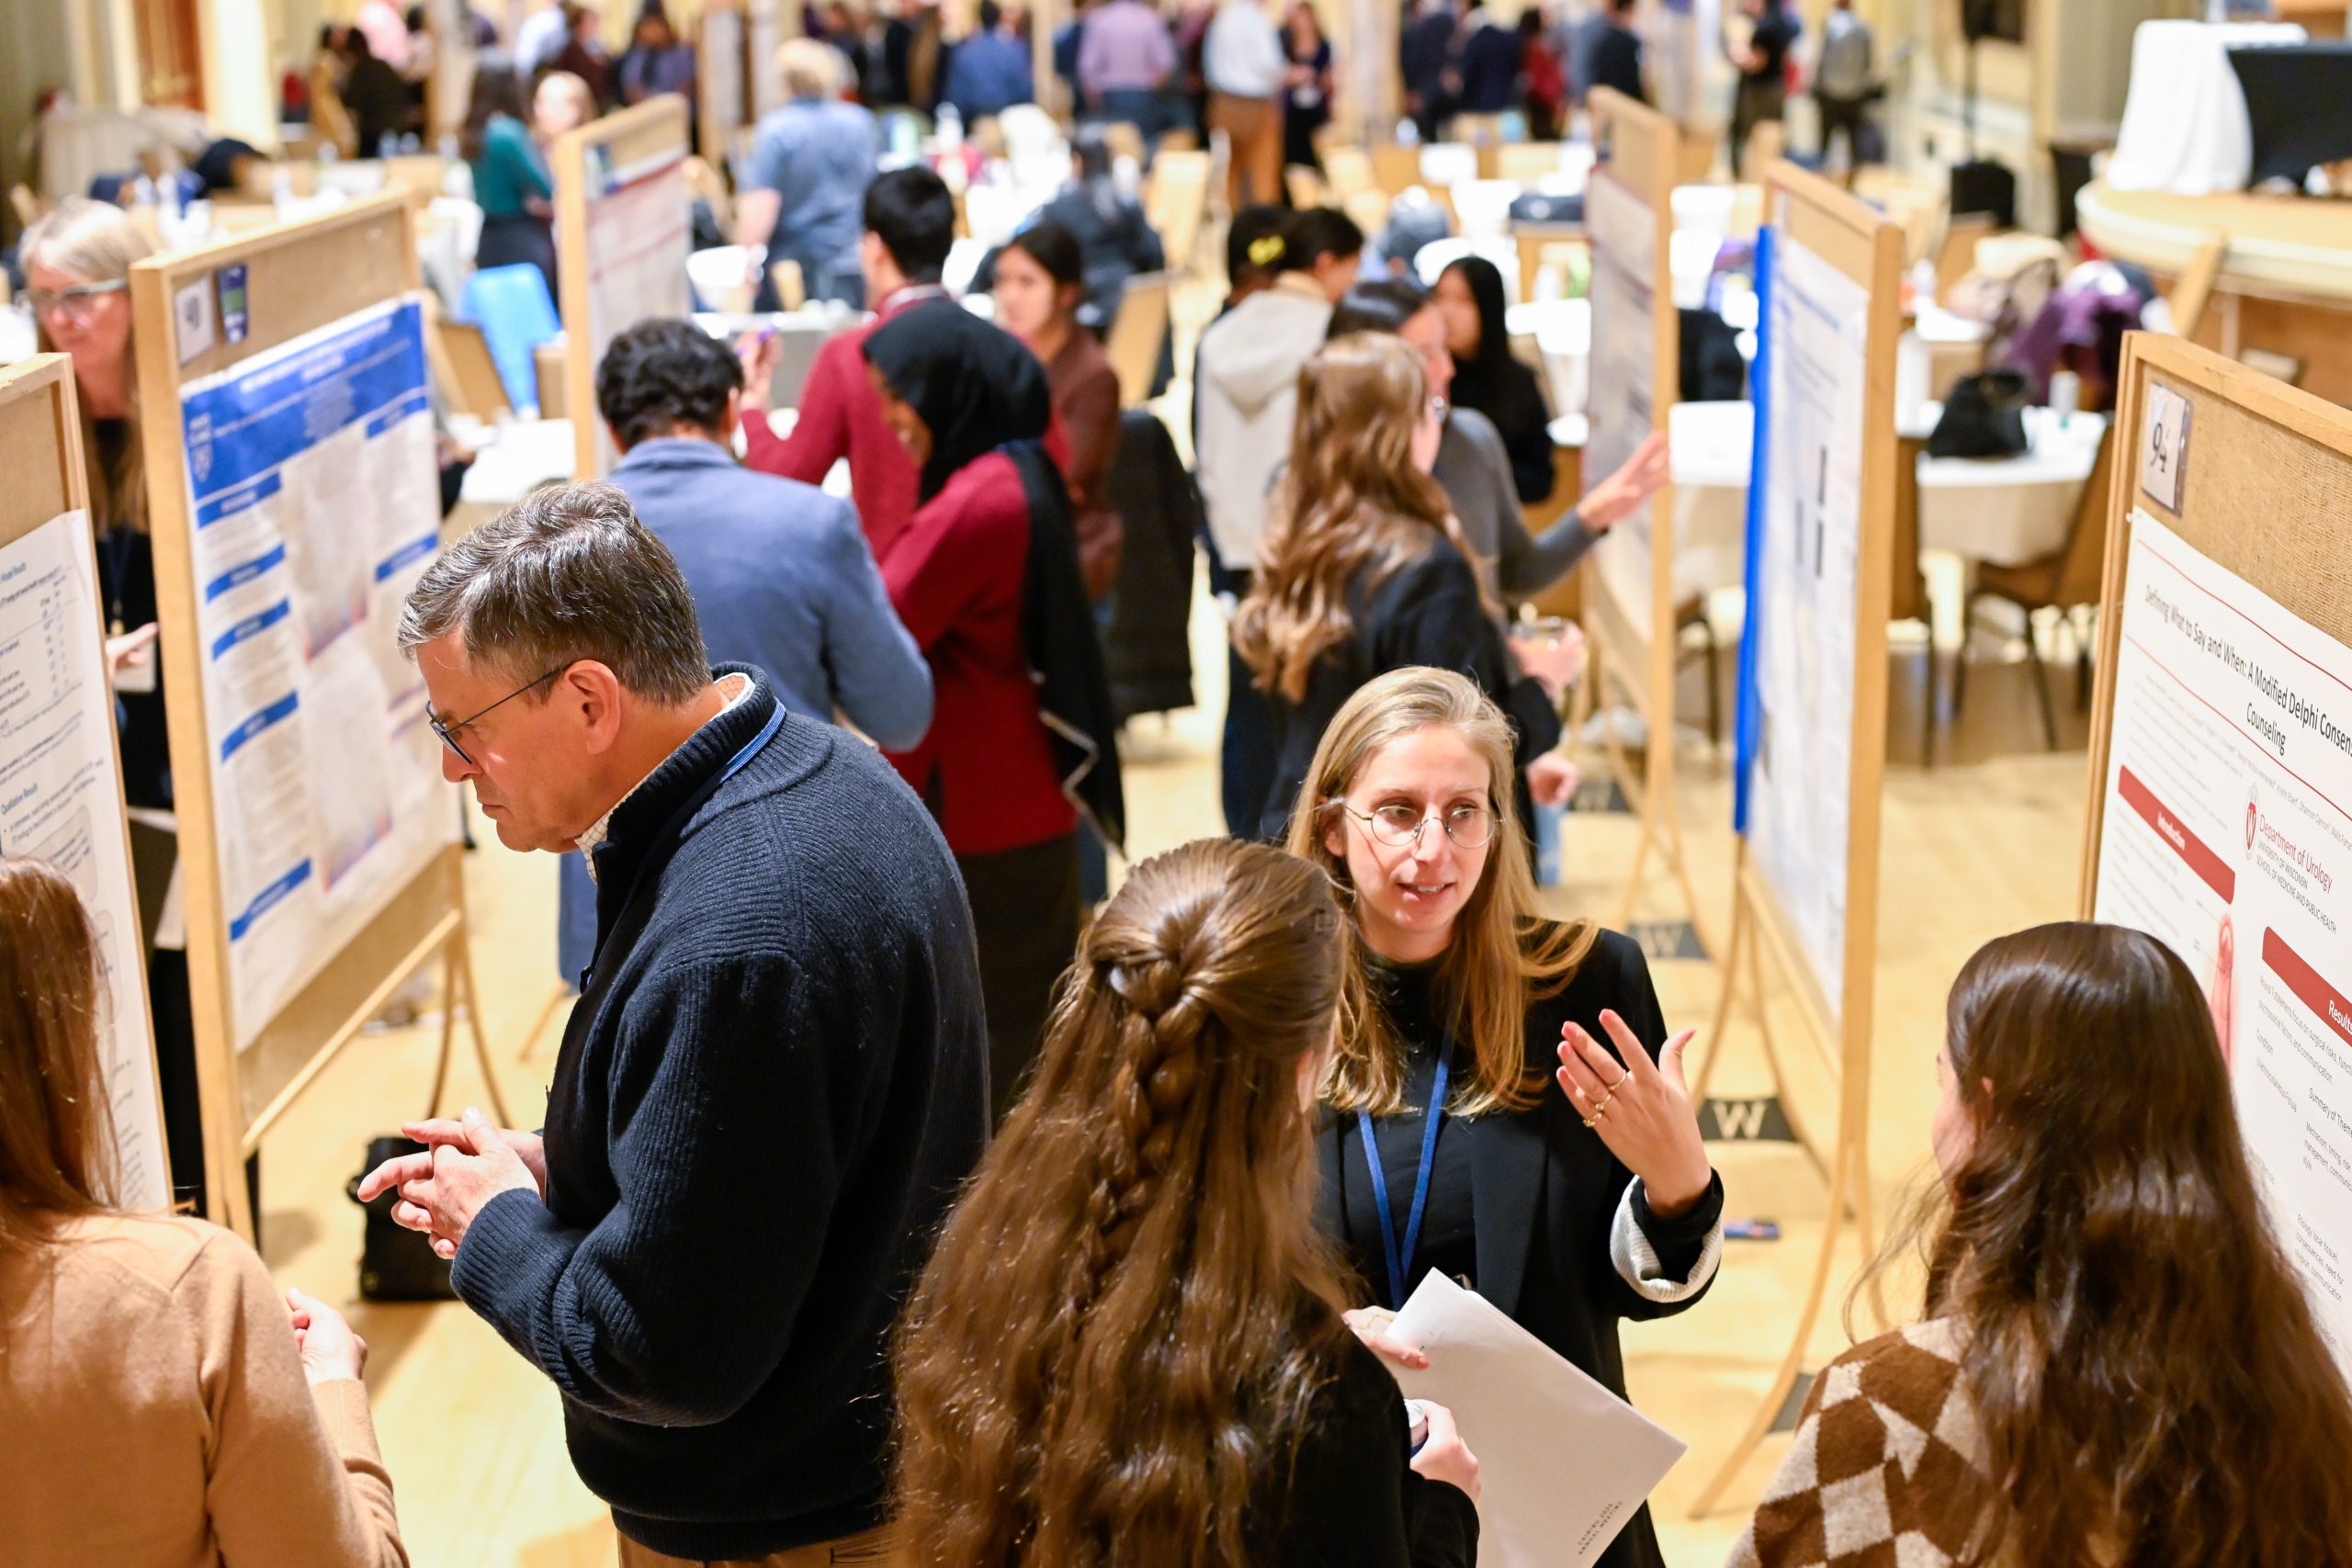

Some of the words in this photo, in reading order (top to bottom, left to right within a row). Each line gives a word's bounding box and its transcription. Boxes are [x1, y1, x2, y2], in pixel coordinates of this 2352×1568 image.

[2193, 622, 2206, 652] Say
[2207, 637, 2222, 658] and
[2223, 641, 2247, 677] When:
[2247, 661, 2254, 683] A
[2254, 666, 2288, 709] Modified
[2289, 692, 2319, 729] Delphi
[2246, 702, 2286, 756] Counseling
[2259, 814, 2297, 861] Department
[2297, 850, 2306, 867] of
[2306, 852, 2333, 894] Urology
[2256, 854, 2271, 877] SCHOOL
[2278, 874, 2296, 898] MEDICINE
[2296, 891, 2305, 906] AND
[2306, 898, 2320, 920] PUBLIC
[2320, 912, 2336, 934] HEALTH
[2285, 862, 2308, 889] WISCONSIN
[2309, 1030, 2326, 1051] surgical
[1713, 1101, 1767, 1140] W
[2309, 1087, 2330, 1119] Summary
[2330, 1111, 2336, 1122] of
[1599, 1500, 1623, 1528] MEETING
